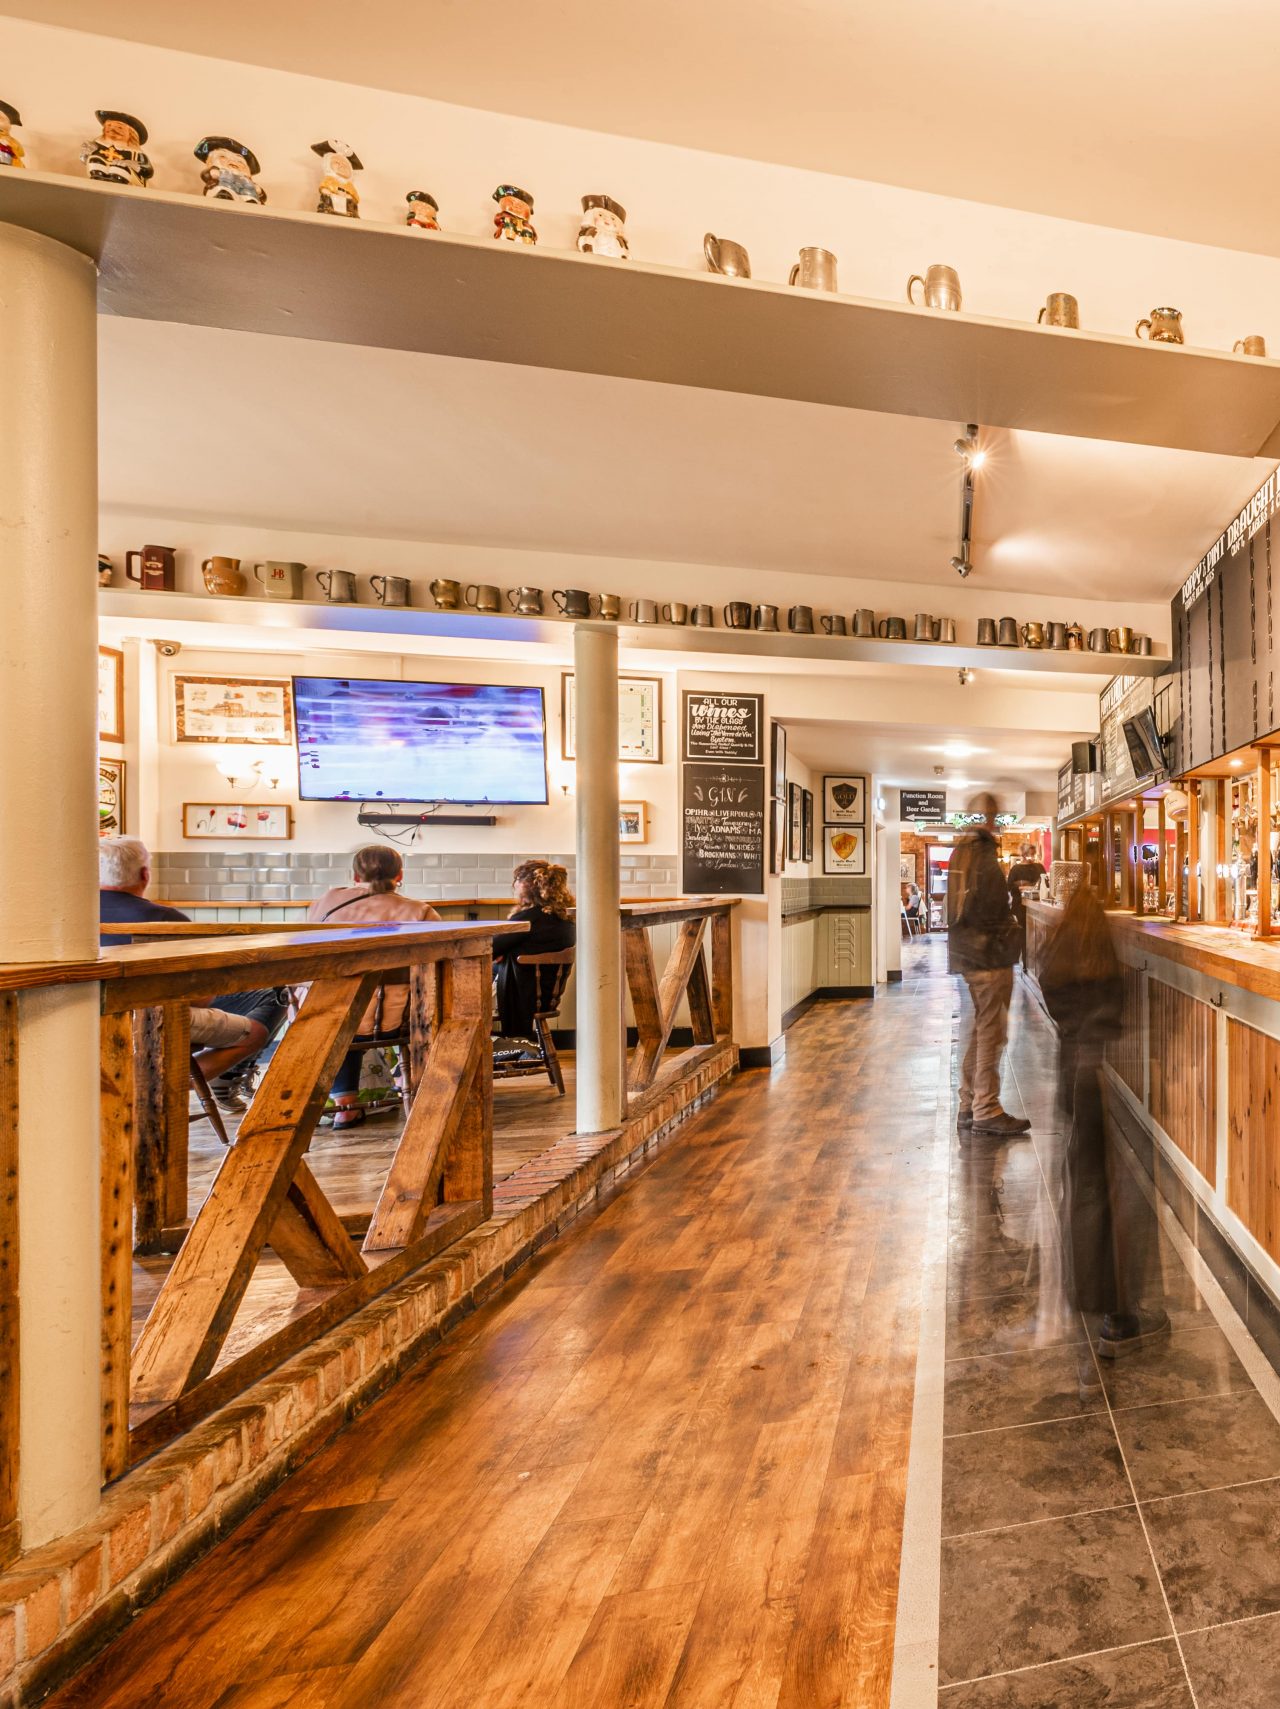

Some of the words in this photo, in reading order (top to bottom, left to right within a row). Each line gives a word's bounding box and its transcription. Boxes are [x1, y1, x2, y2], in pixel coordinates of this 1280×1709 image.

[1207, 533, 1225, 572] PINT
[1227, 472, 1275, 550] DRAUGHT
[1248, 508, 1268, 540] LAGERS
[690, 704, 751, 718] Wines
[708, 787, 736, 807] GIN
[710, 825, 740, 833] ADNAMS
